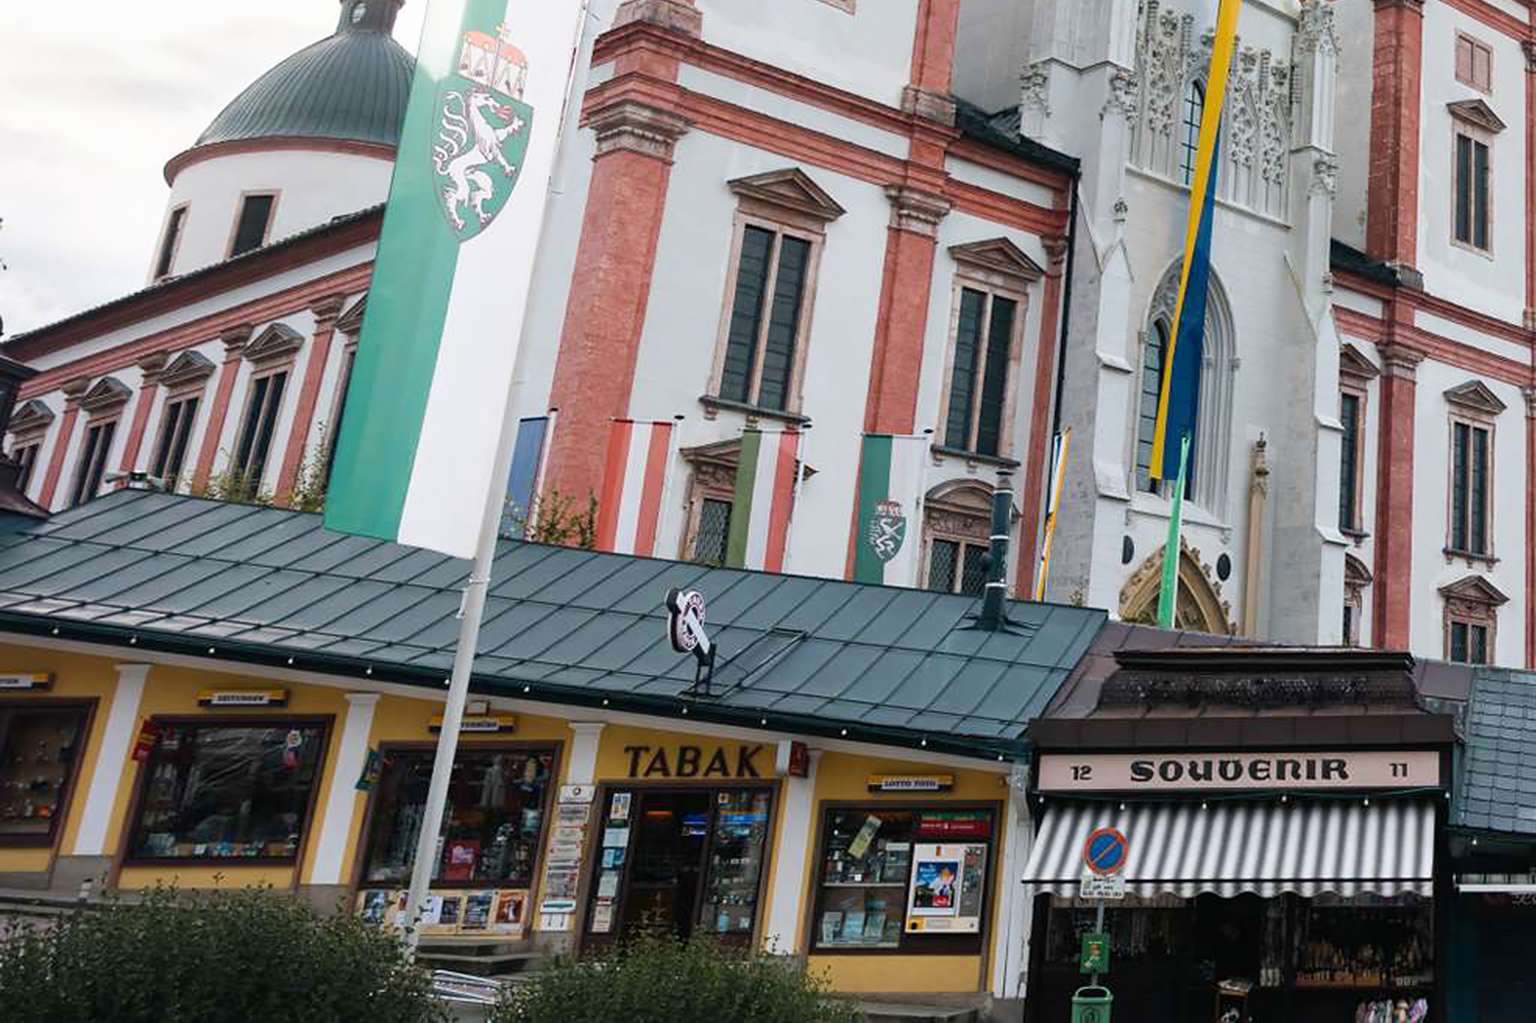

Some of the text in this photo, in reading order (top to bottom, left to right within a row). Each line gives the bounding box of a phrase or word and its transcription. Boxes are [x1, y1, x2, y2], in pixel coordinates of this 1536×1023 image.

[624, 744, 764, 778] TABAK
[1071, 759, 1408, 782] 12 SOUVENIR 11
